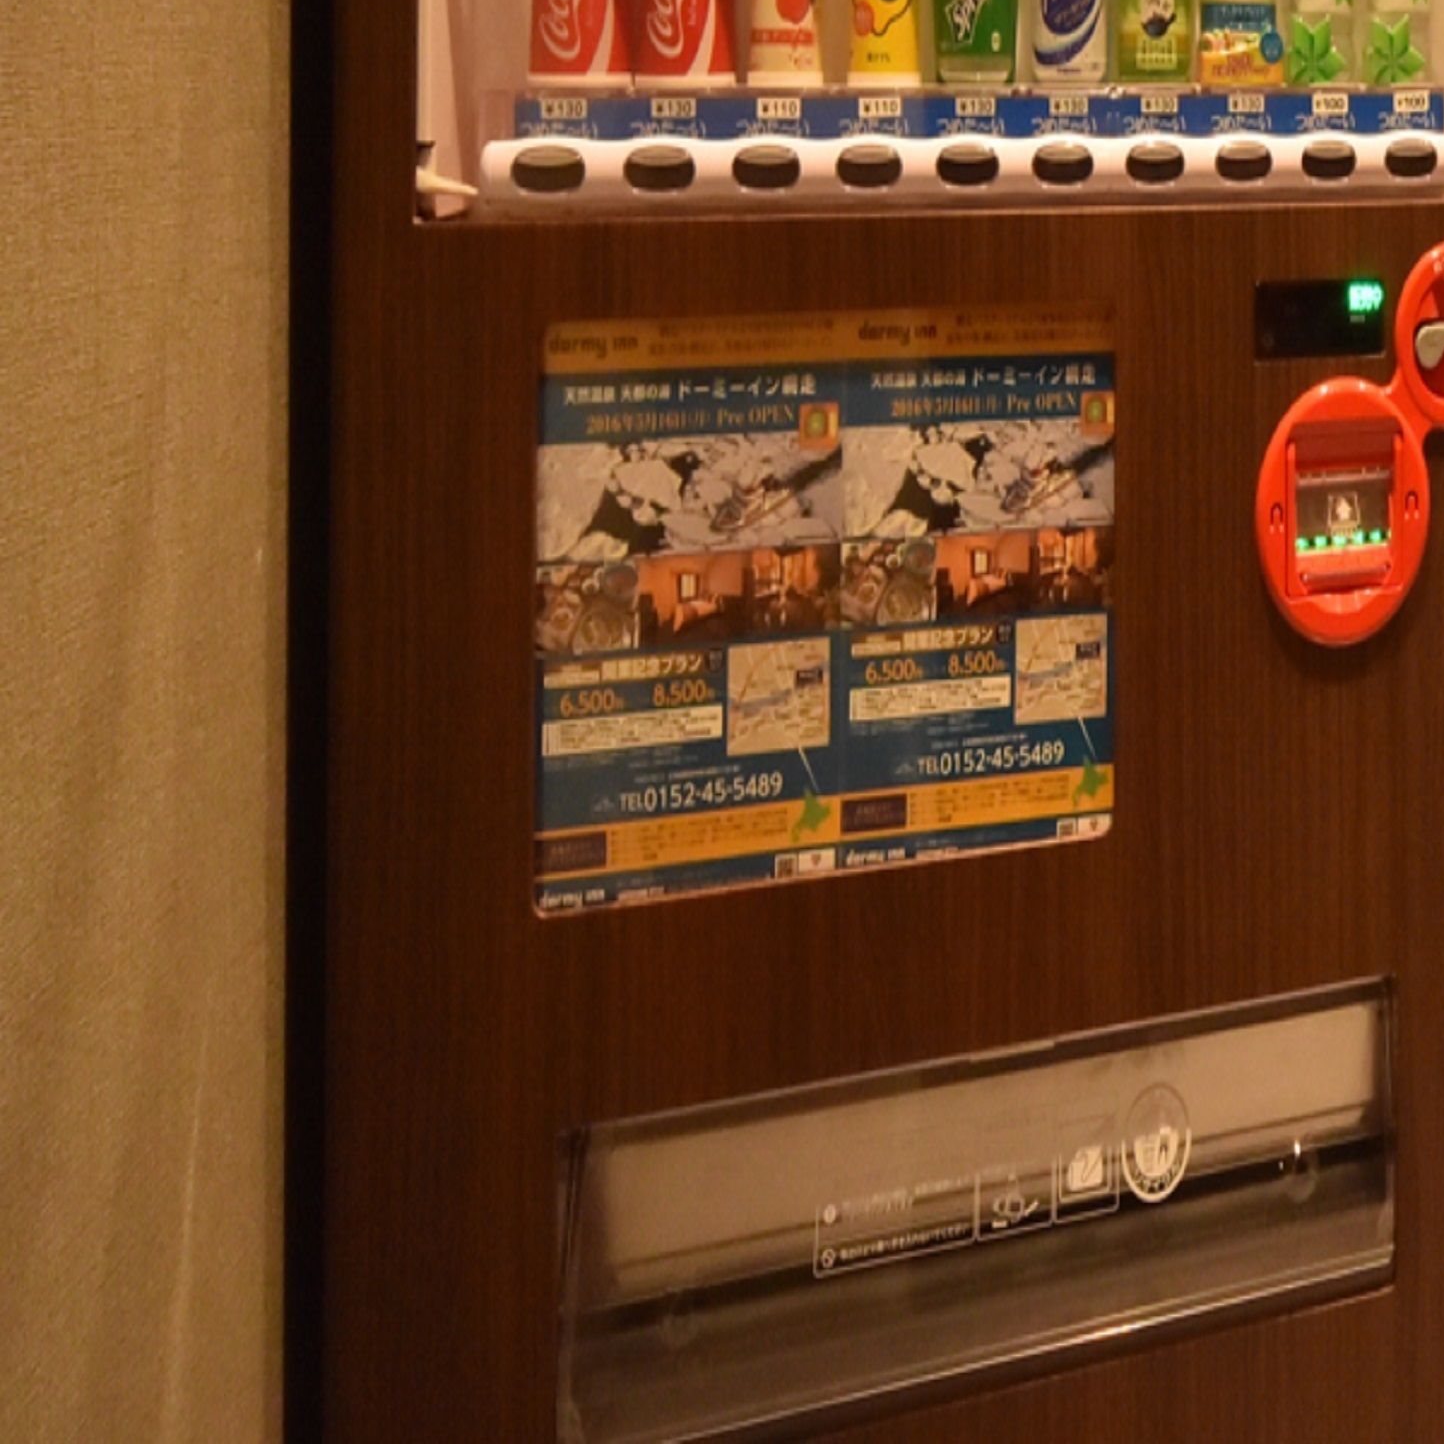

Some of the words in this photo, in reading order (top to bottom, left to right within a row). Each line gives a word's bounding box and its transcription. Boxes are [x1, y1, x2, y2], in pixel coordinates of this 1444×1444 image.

[858, 320, 911, 346] dormy
[915, 324, 938, 338] inn
[551, 335, 607, 359] dormy
[613, 336, 638, 350] inn
[748, 404, 794, 425] OPEN
